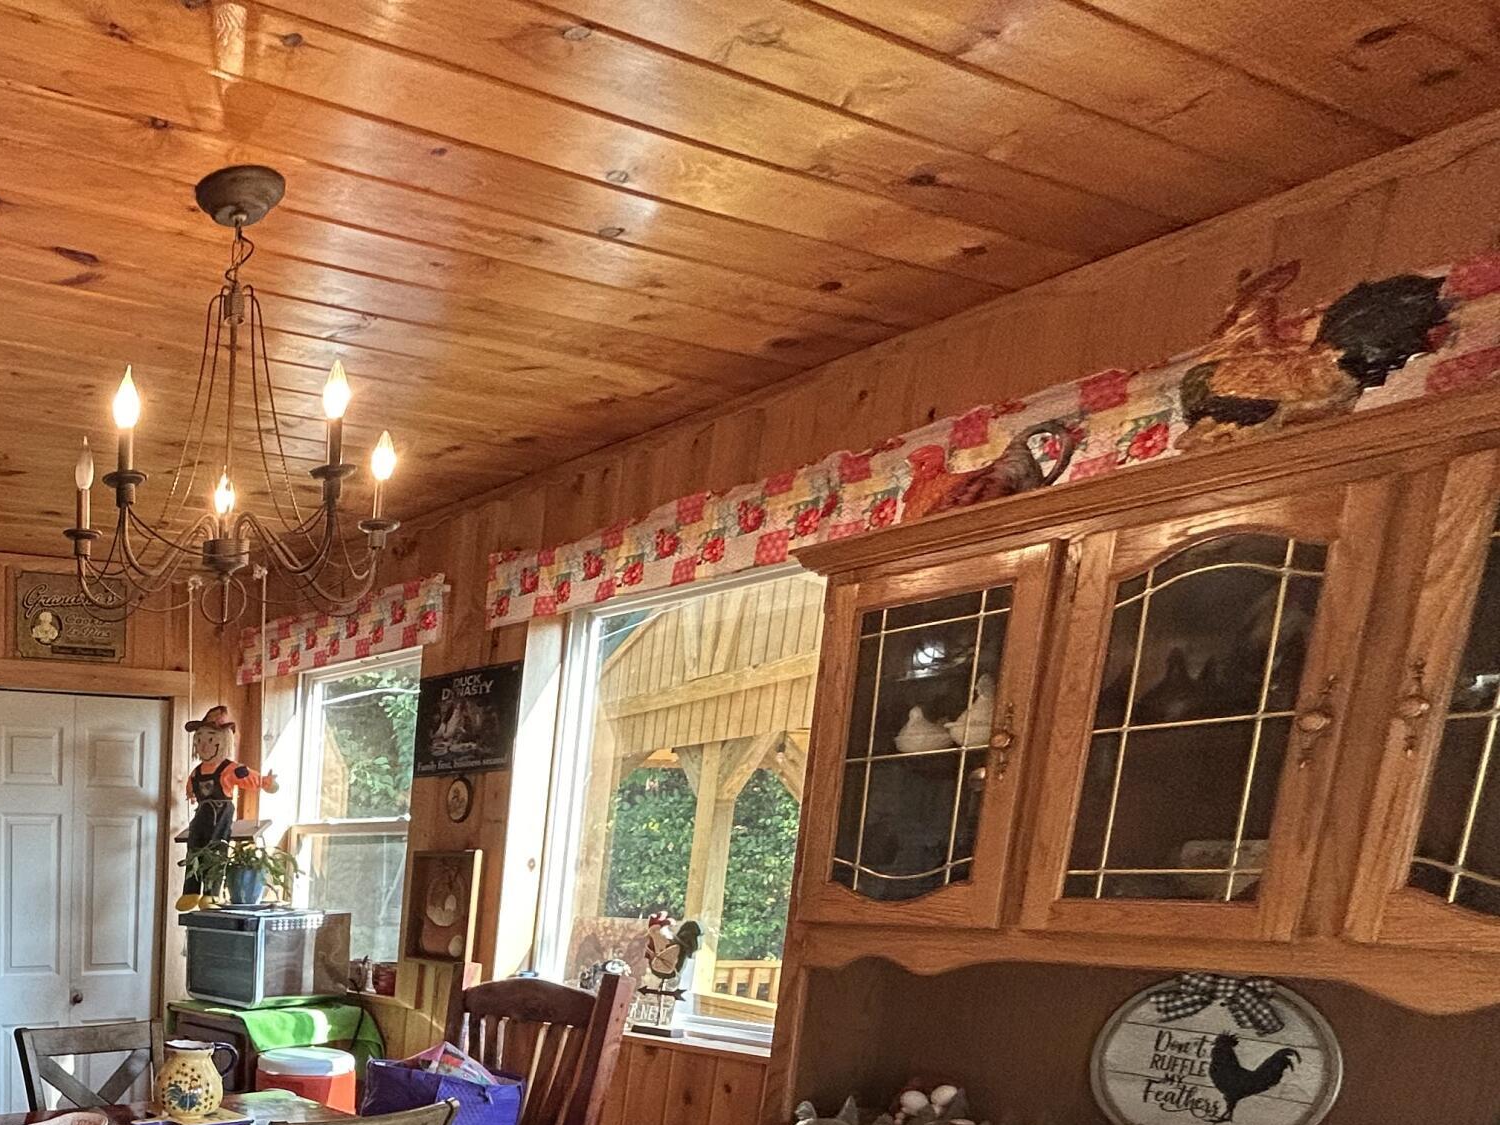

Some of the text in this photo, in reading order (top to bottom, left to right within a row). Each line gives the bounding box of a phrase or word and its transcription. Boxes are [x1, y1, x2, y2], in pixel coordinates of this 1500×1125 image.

[23, 583, 117, 619] Granda's
[452, 673, 483, 689] DUCK
[1153, 1030, 1209, 1058] Don't
[1149, 1053, 1209, 1078] RUFFLE
[1164, 1073, 1187, 1087] MY
[1142, 1079, 1220, 1118] Feathers
